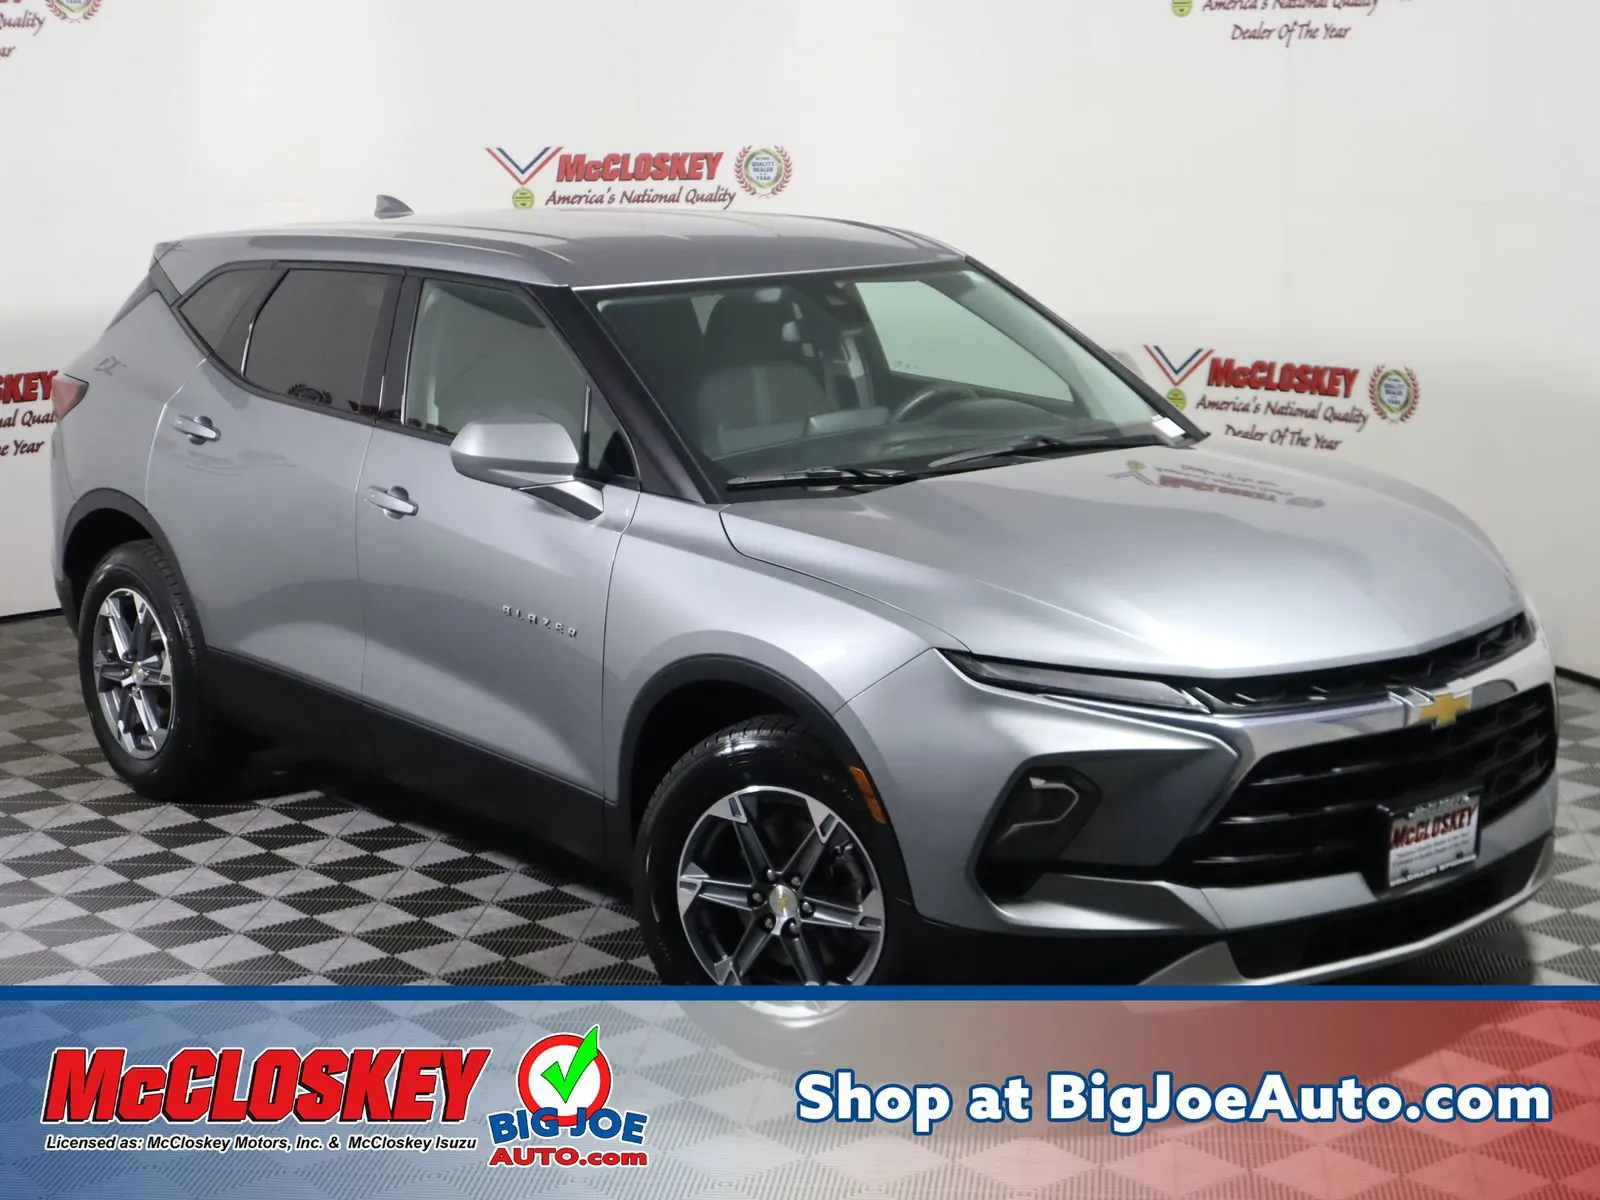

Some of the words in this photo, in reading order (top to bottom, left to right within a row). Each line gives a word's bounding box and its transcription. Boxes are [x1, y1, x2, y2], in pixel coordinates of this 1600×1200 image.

[0, 9, 45, 36] uality
[1230, 20, 1276, 40] Dealer
[1277, 20, 1298, 48] Of
[1298, 20, 1320, 40] The
[1322, 23, 1352, 40] Year
[556, 152, 724, 182] McCLOSKEY
[545, 187, 616, 206] America's
[619, 186, 684, 204] National
[685, 185, 737, 210] Quality
[0, 370, 59, 404] KEY
[1207, 357, 1360, 399] McCLOSKEY
[21, 410, 56, 427] Qual
[1195, 394, 1261, 415] America's
[1264, 399, 1324, 420] National
[1323, 405, 1371, 433] Quality
[13, 439, 45, 456] Year
[1223, 423, 1269, 442] Dealer
[1269, 426, 1291, 447] Of
[1288, 428, 1311, 448] The
[1313, 432, 1344, 451] Year
[502, 605, 578, 639] BLAZER
